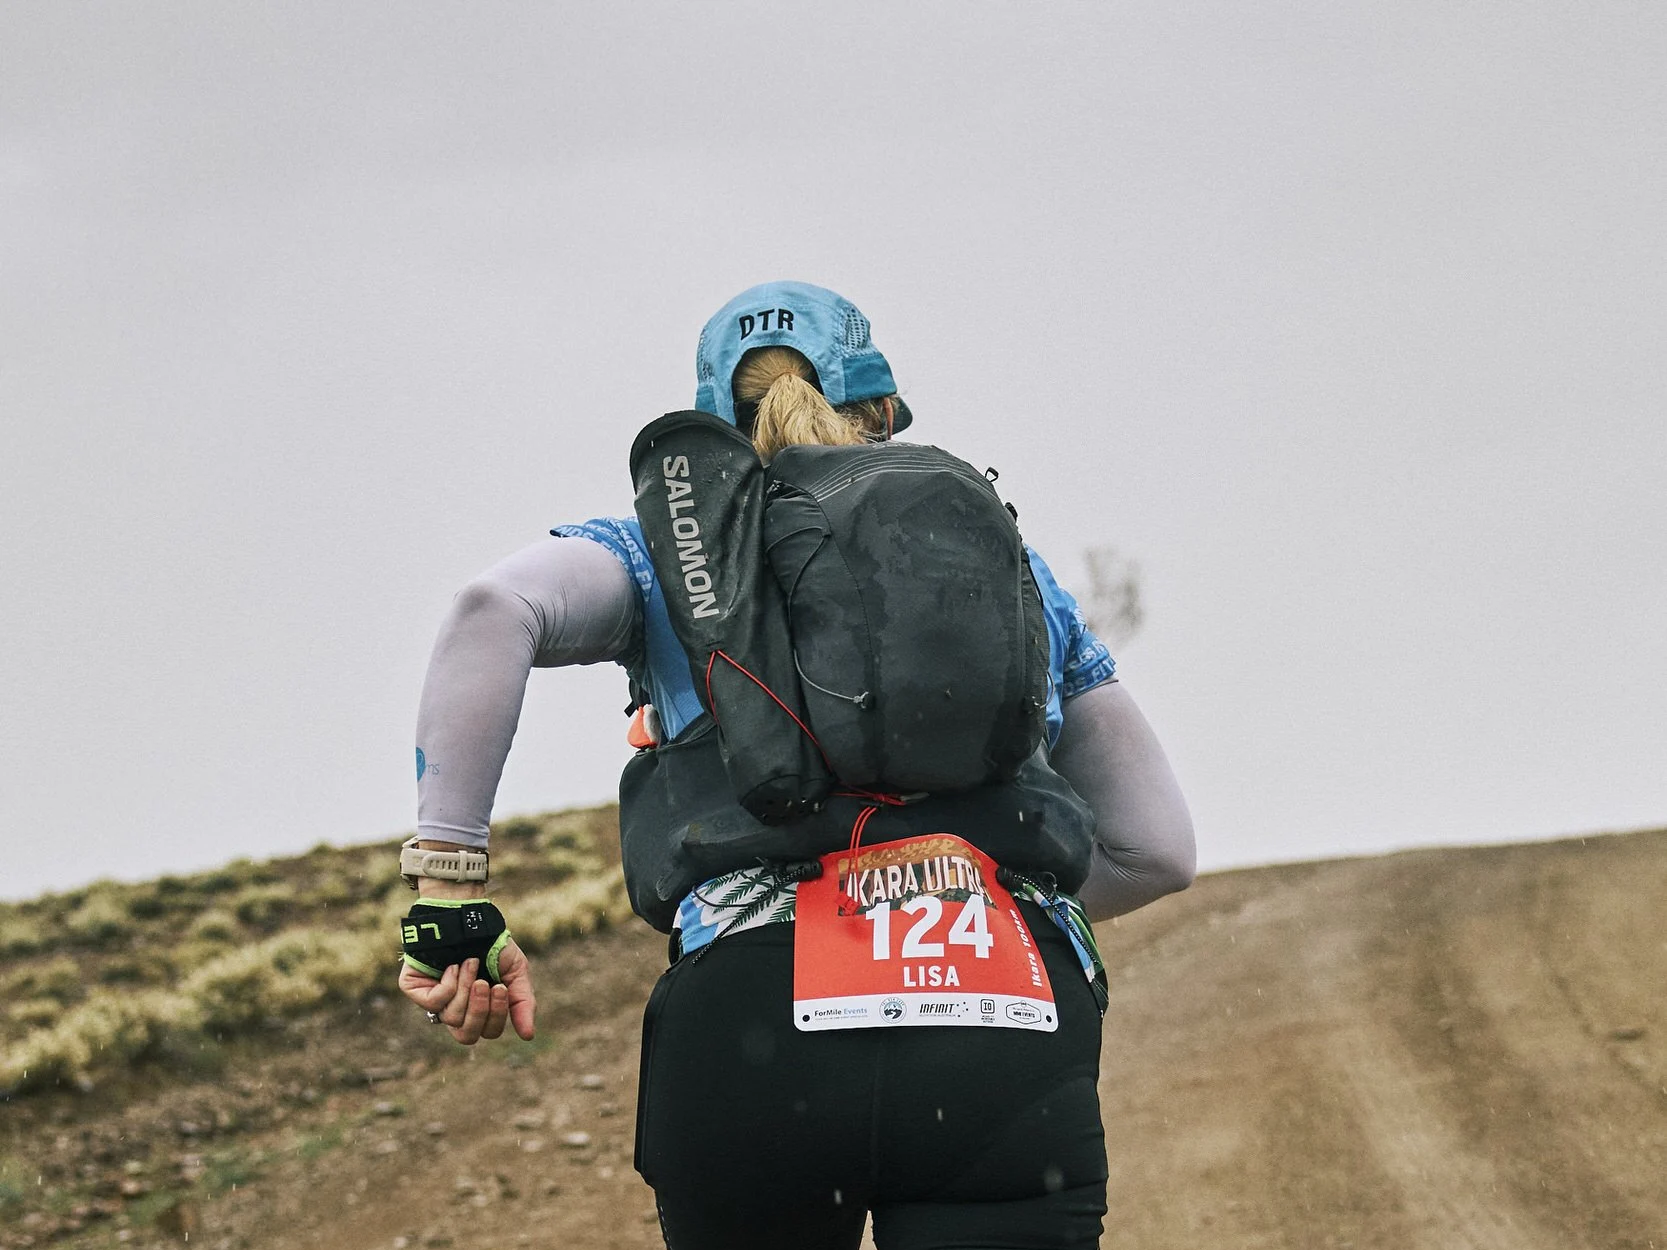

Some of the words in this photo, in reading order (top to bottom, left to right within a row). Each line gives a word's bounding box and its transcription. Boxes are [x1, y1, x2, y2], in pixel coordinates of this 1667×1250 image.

[738, 308, 795, 340] DTR
[662, 455, 720, 619] SALOMON
[865, 894, 994, 960] 124
[903, 965, 960, 987] LISA
[1027, 952, 1043, 987] Ikara
[814, 1009, 842, 1017] ForMile
[843, 1007, 868, 1015] Events
[919, 1003, 956, 1014] INFINIT
